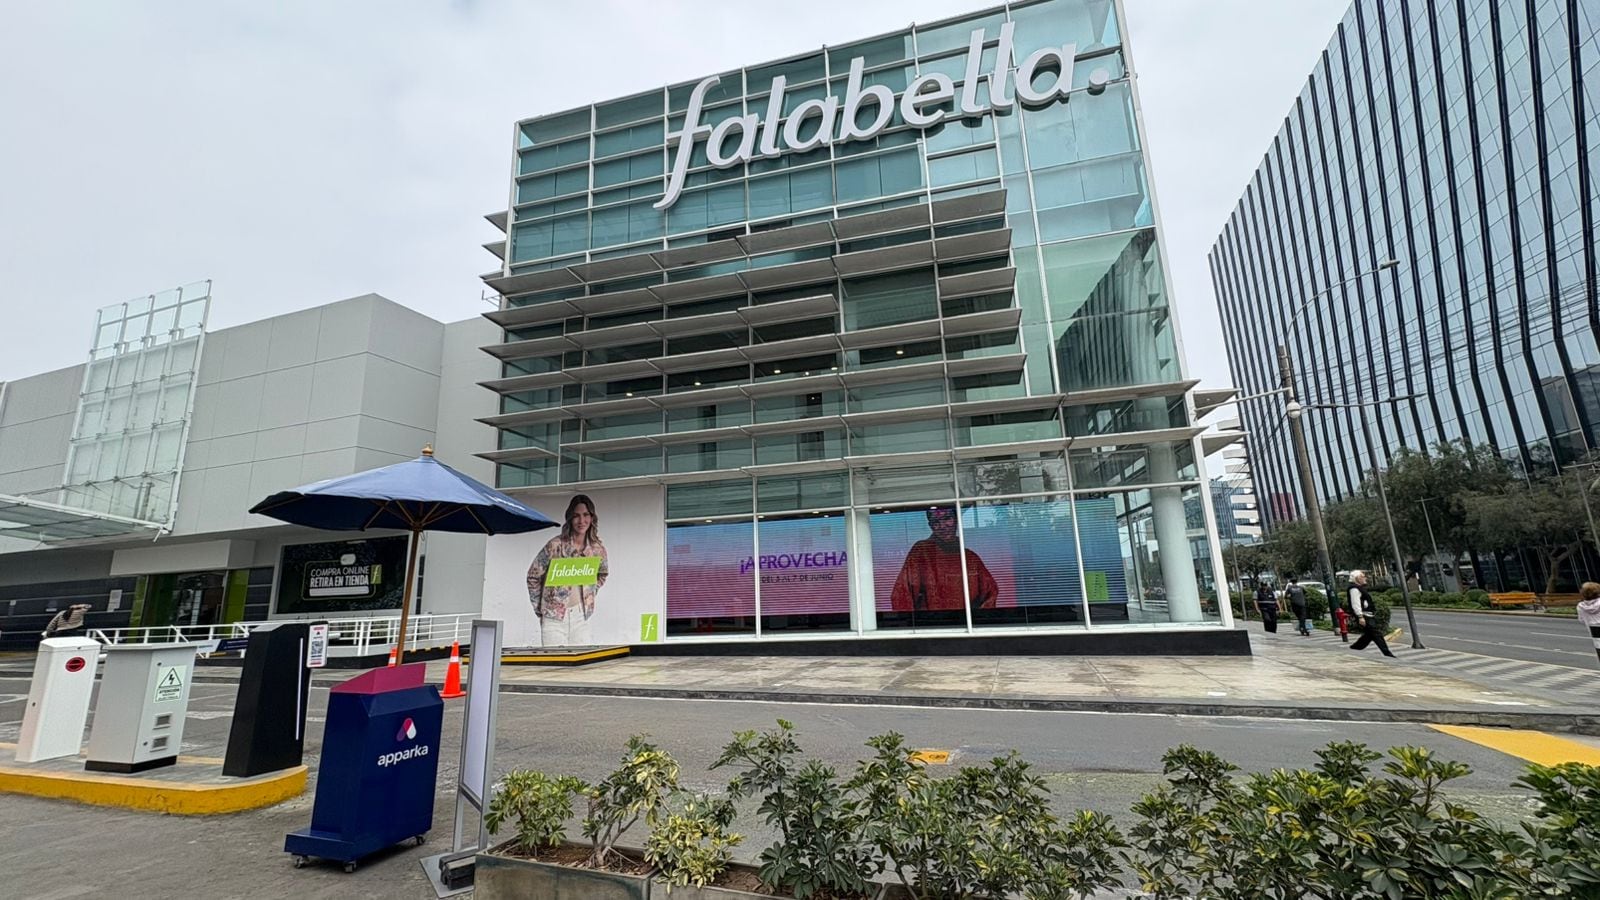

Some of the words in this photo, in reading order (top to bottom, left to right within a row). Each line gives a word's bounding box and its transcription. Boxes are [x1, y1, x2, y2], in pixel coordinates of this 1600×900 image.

[310, 568, 341, 577] COMPRA
[342, 565, 370, 575] ONLINE
[799, 573, 809, 582] DE
[811, 573, 834, 582] JUNIO
[310, 576, 334, 588] RETIRA
[334, 575, 344, 587] EN
[345, 574, 370, 586] TIENDA
[377, 744, 429, 767] apparka
